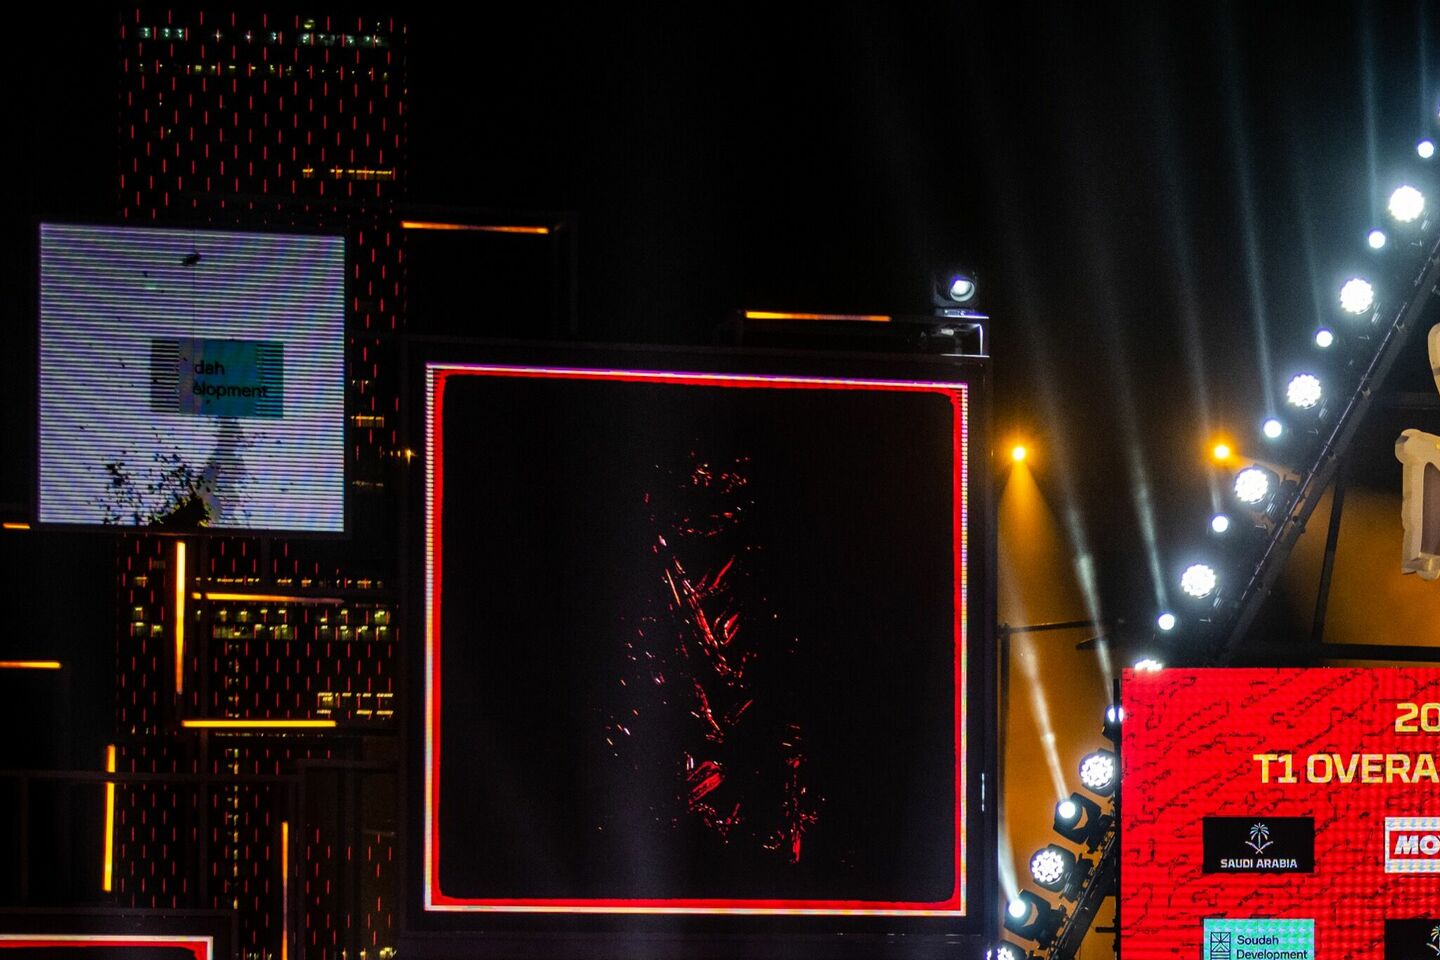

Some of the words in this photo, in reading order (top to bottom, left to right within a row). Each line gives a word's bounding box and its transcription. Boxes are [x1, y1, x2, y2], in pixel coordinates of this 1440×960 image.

[1253, 754, 1299, 784] T1
[1220, 858, 1254, 868] SAUDI
[1256, 858, 1298, 868] ARABIA
[1237, 935, 1279, 945] Soudah
[1236, 949, 1308, 960] Development
